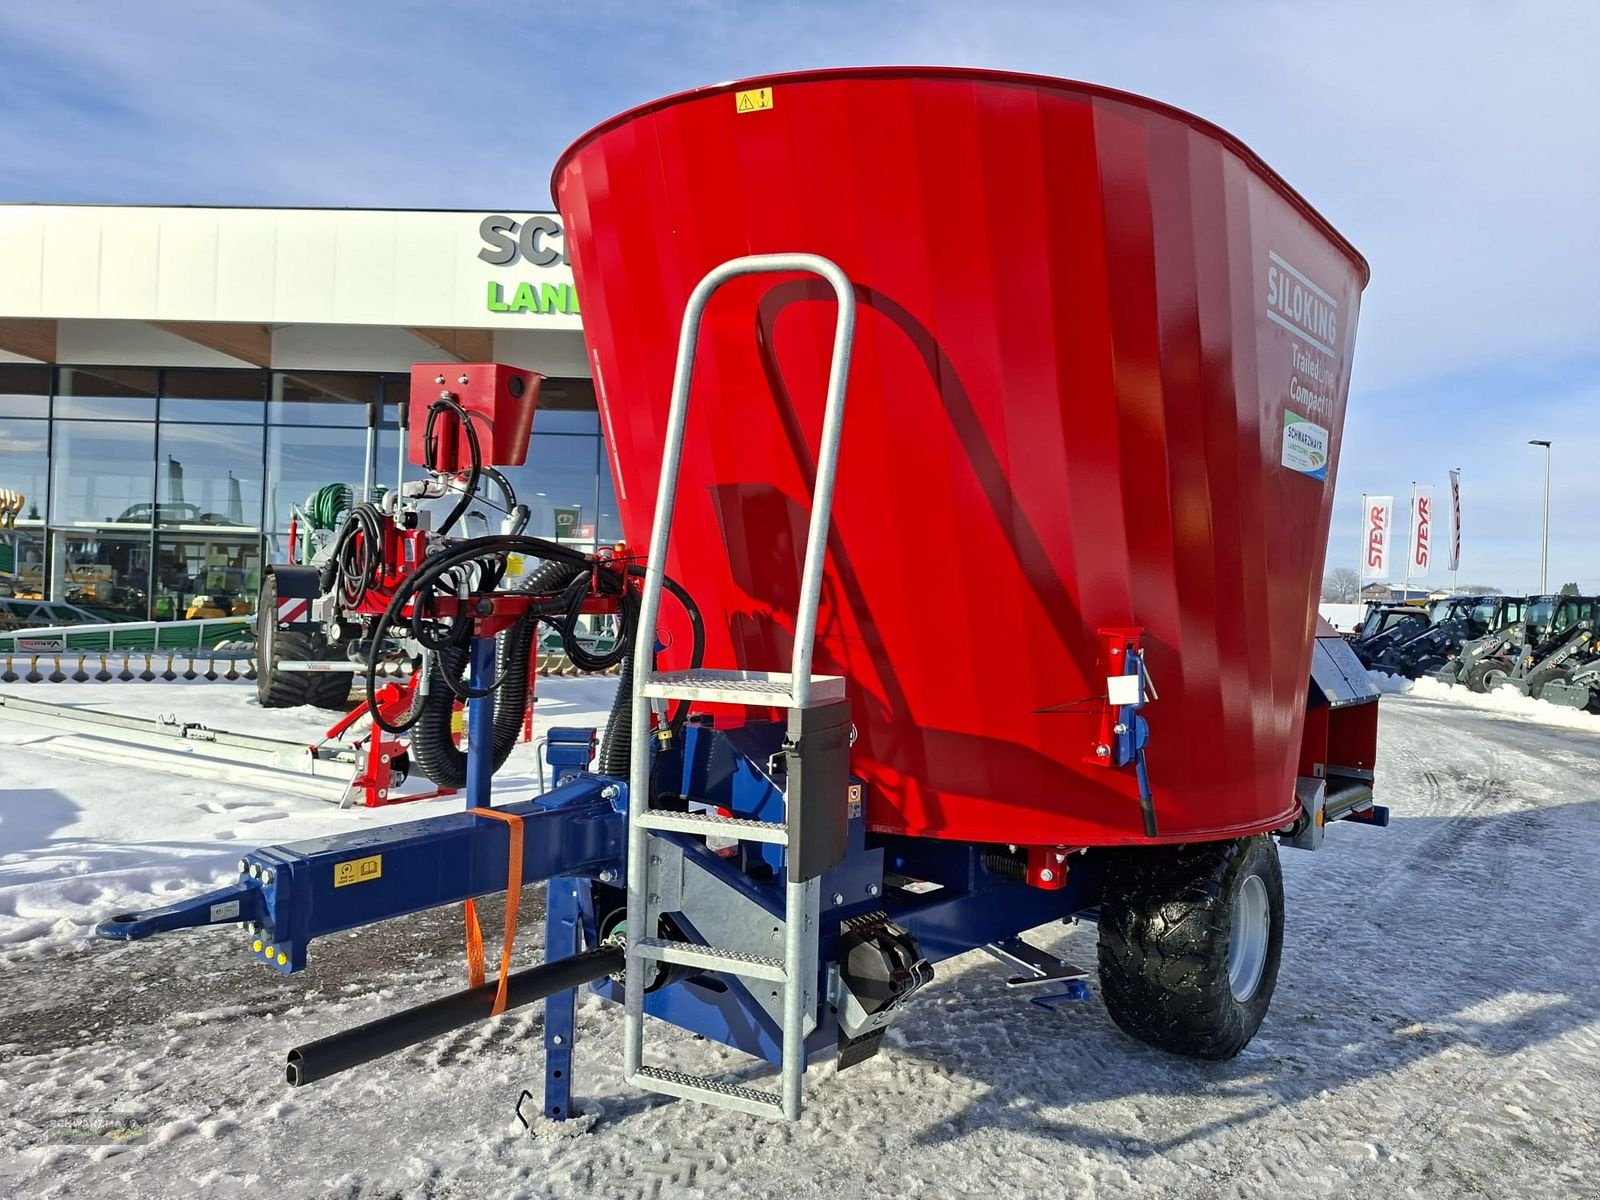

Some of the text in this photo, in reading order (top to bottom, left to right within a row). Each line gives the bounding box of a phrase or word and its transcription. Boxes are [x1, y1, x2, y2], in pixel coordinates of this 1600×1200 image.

[1267, 266, 1336, 345] SILOKING
[1368, 506, 1385, 570] STEYR
[1415, 497, 1429, 568] STEYR
